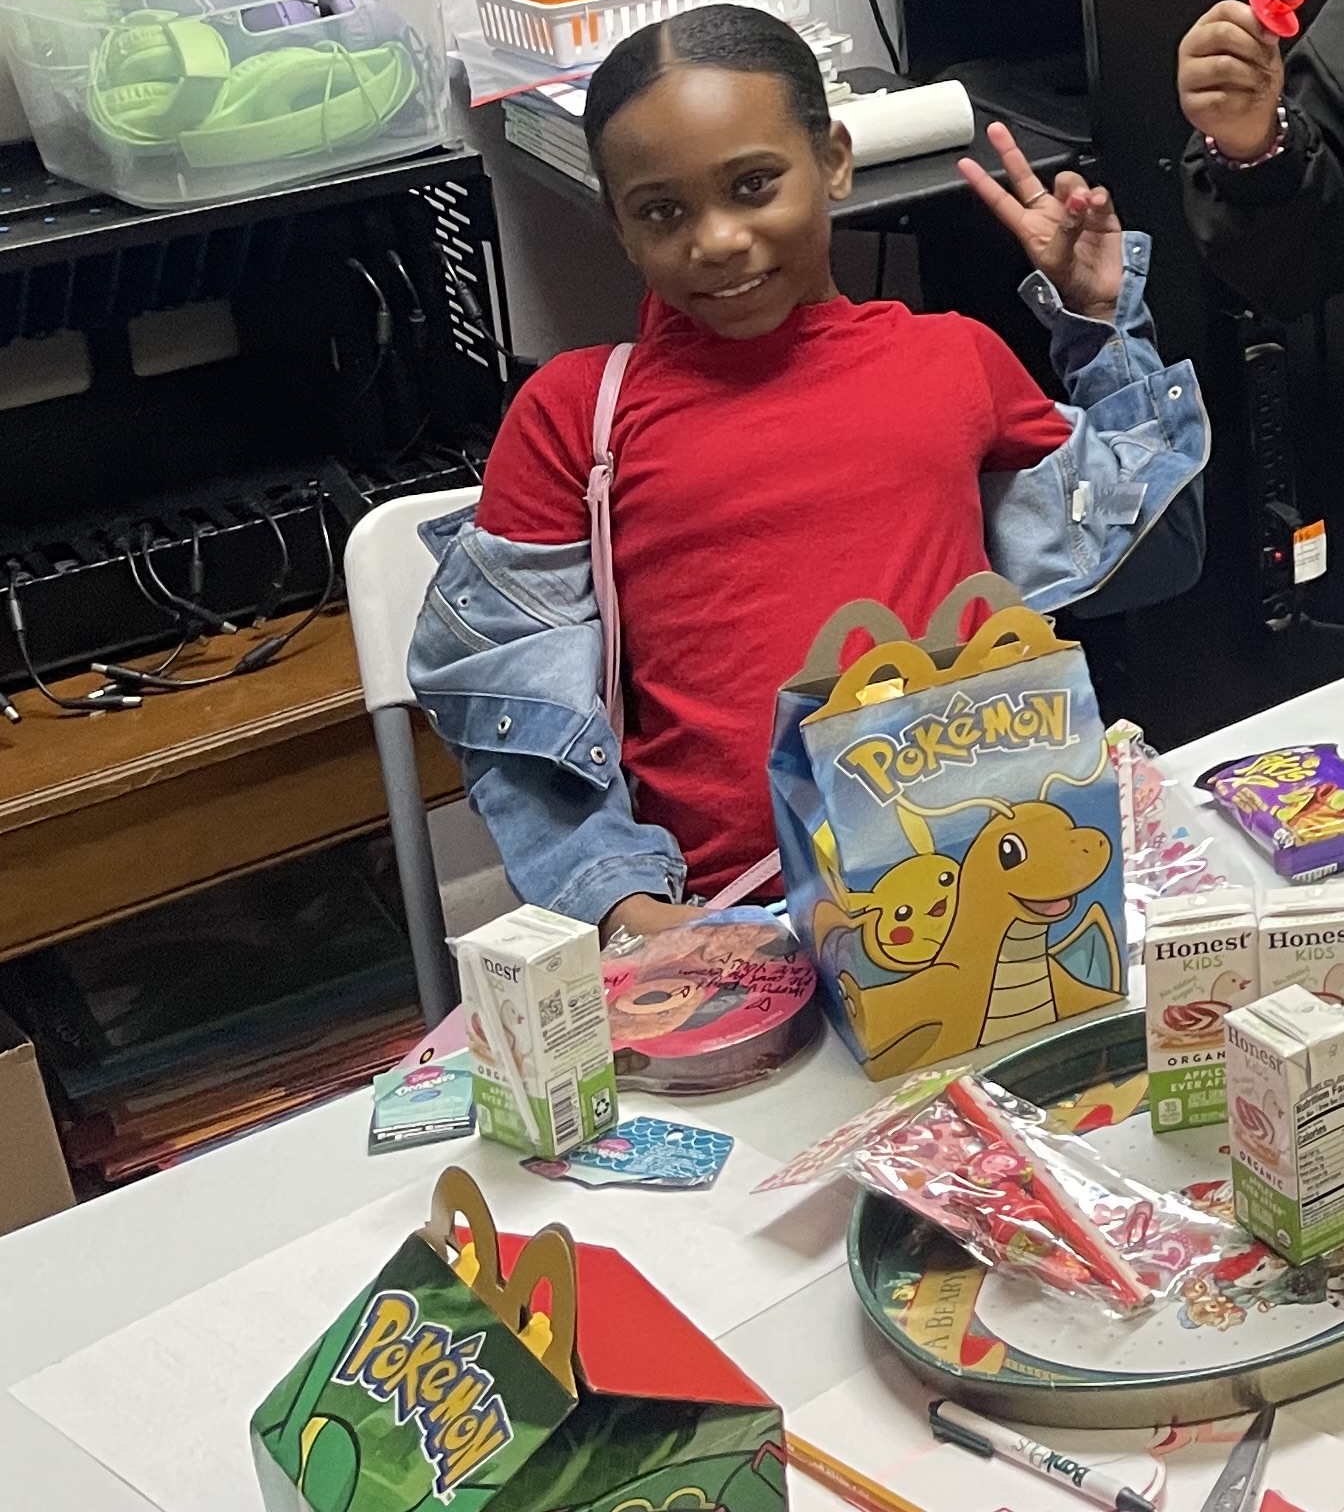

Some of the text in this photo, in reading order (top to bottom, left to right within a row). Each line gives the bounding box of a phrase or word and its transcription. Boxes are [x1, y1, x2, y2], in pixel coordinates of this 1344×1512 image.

[1155, 932, 1252, 961] Honest
[484, 958, 521, 983] nest
[1168, 1051, 1226, 1066] ORGAN
[1227, 1023, 1283, 1076] Honest
[1239, 1150, 1284, 1191] ORGANIC
[925, 1272, 967, 1328] BEARY
